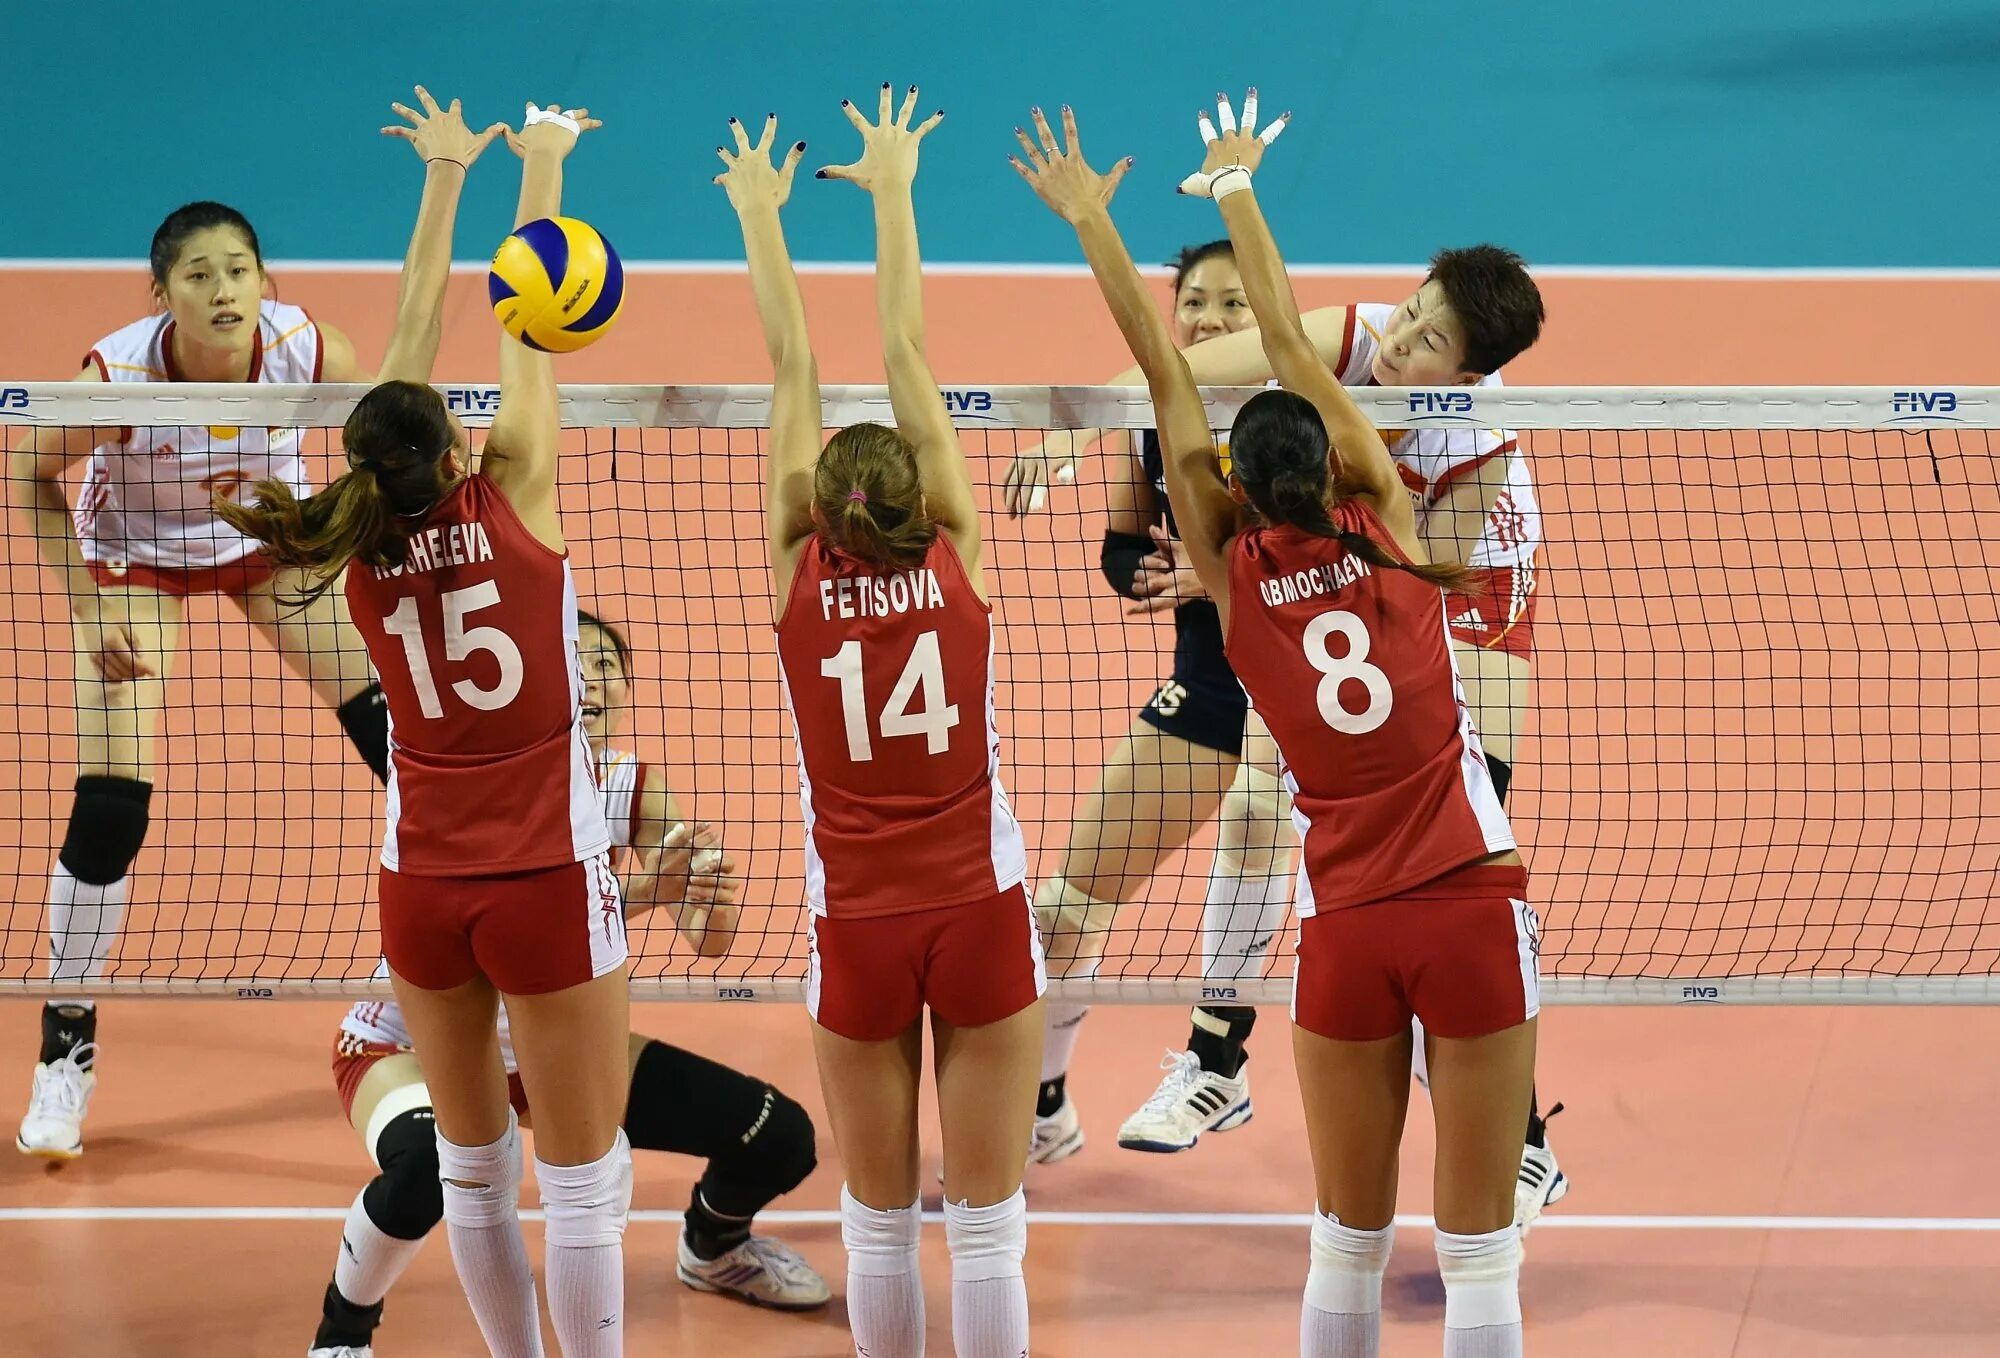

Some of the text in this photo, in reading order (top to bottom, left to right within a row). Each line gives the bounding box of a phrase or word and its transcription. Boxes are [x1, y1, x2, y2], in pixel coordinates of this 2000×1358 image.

[1410, 393, 1472, 412] FIVB
[1894, 393, 1956, 411] FIVB
[820, 569, 945, 620] FETISOVA
[383, 579, 524, 719] 15
[1303, 610, 1393, 734] 8
[821, 630, 960, 762] 14
[719, 989, 753, 997] FIVB
[1203, 988, 1236, 997] FIVB
[1683, 988, 1717, 997] FIVB
